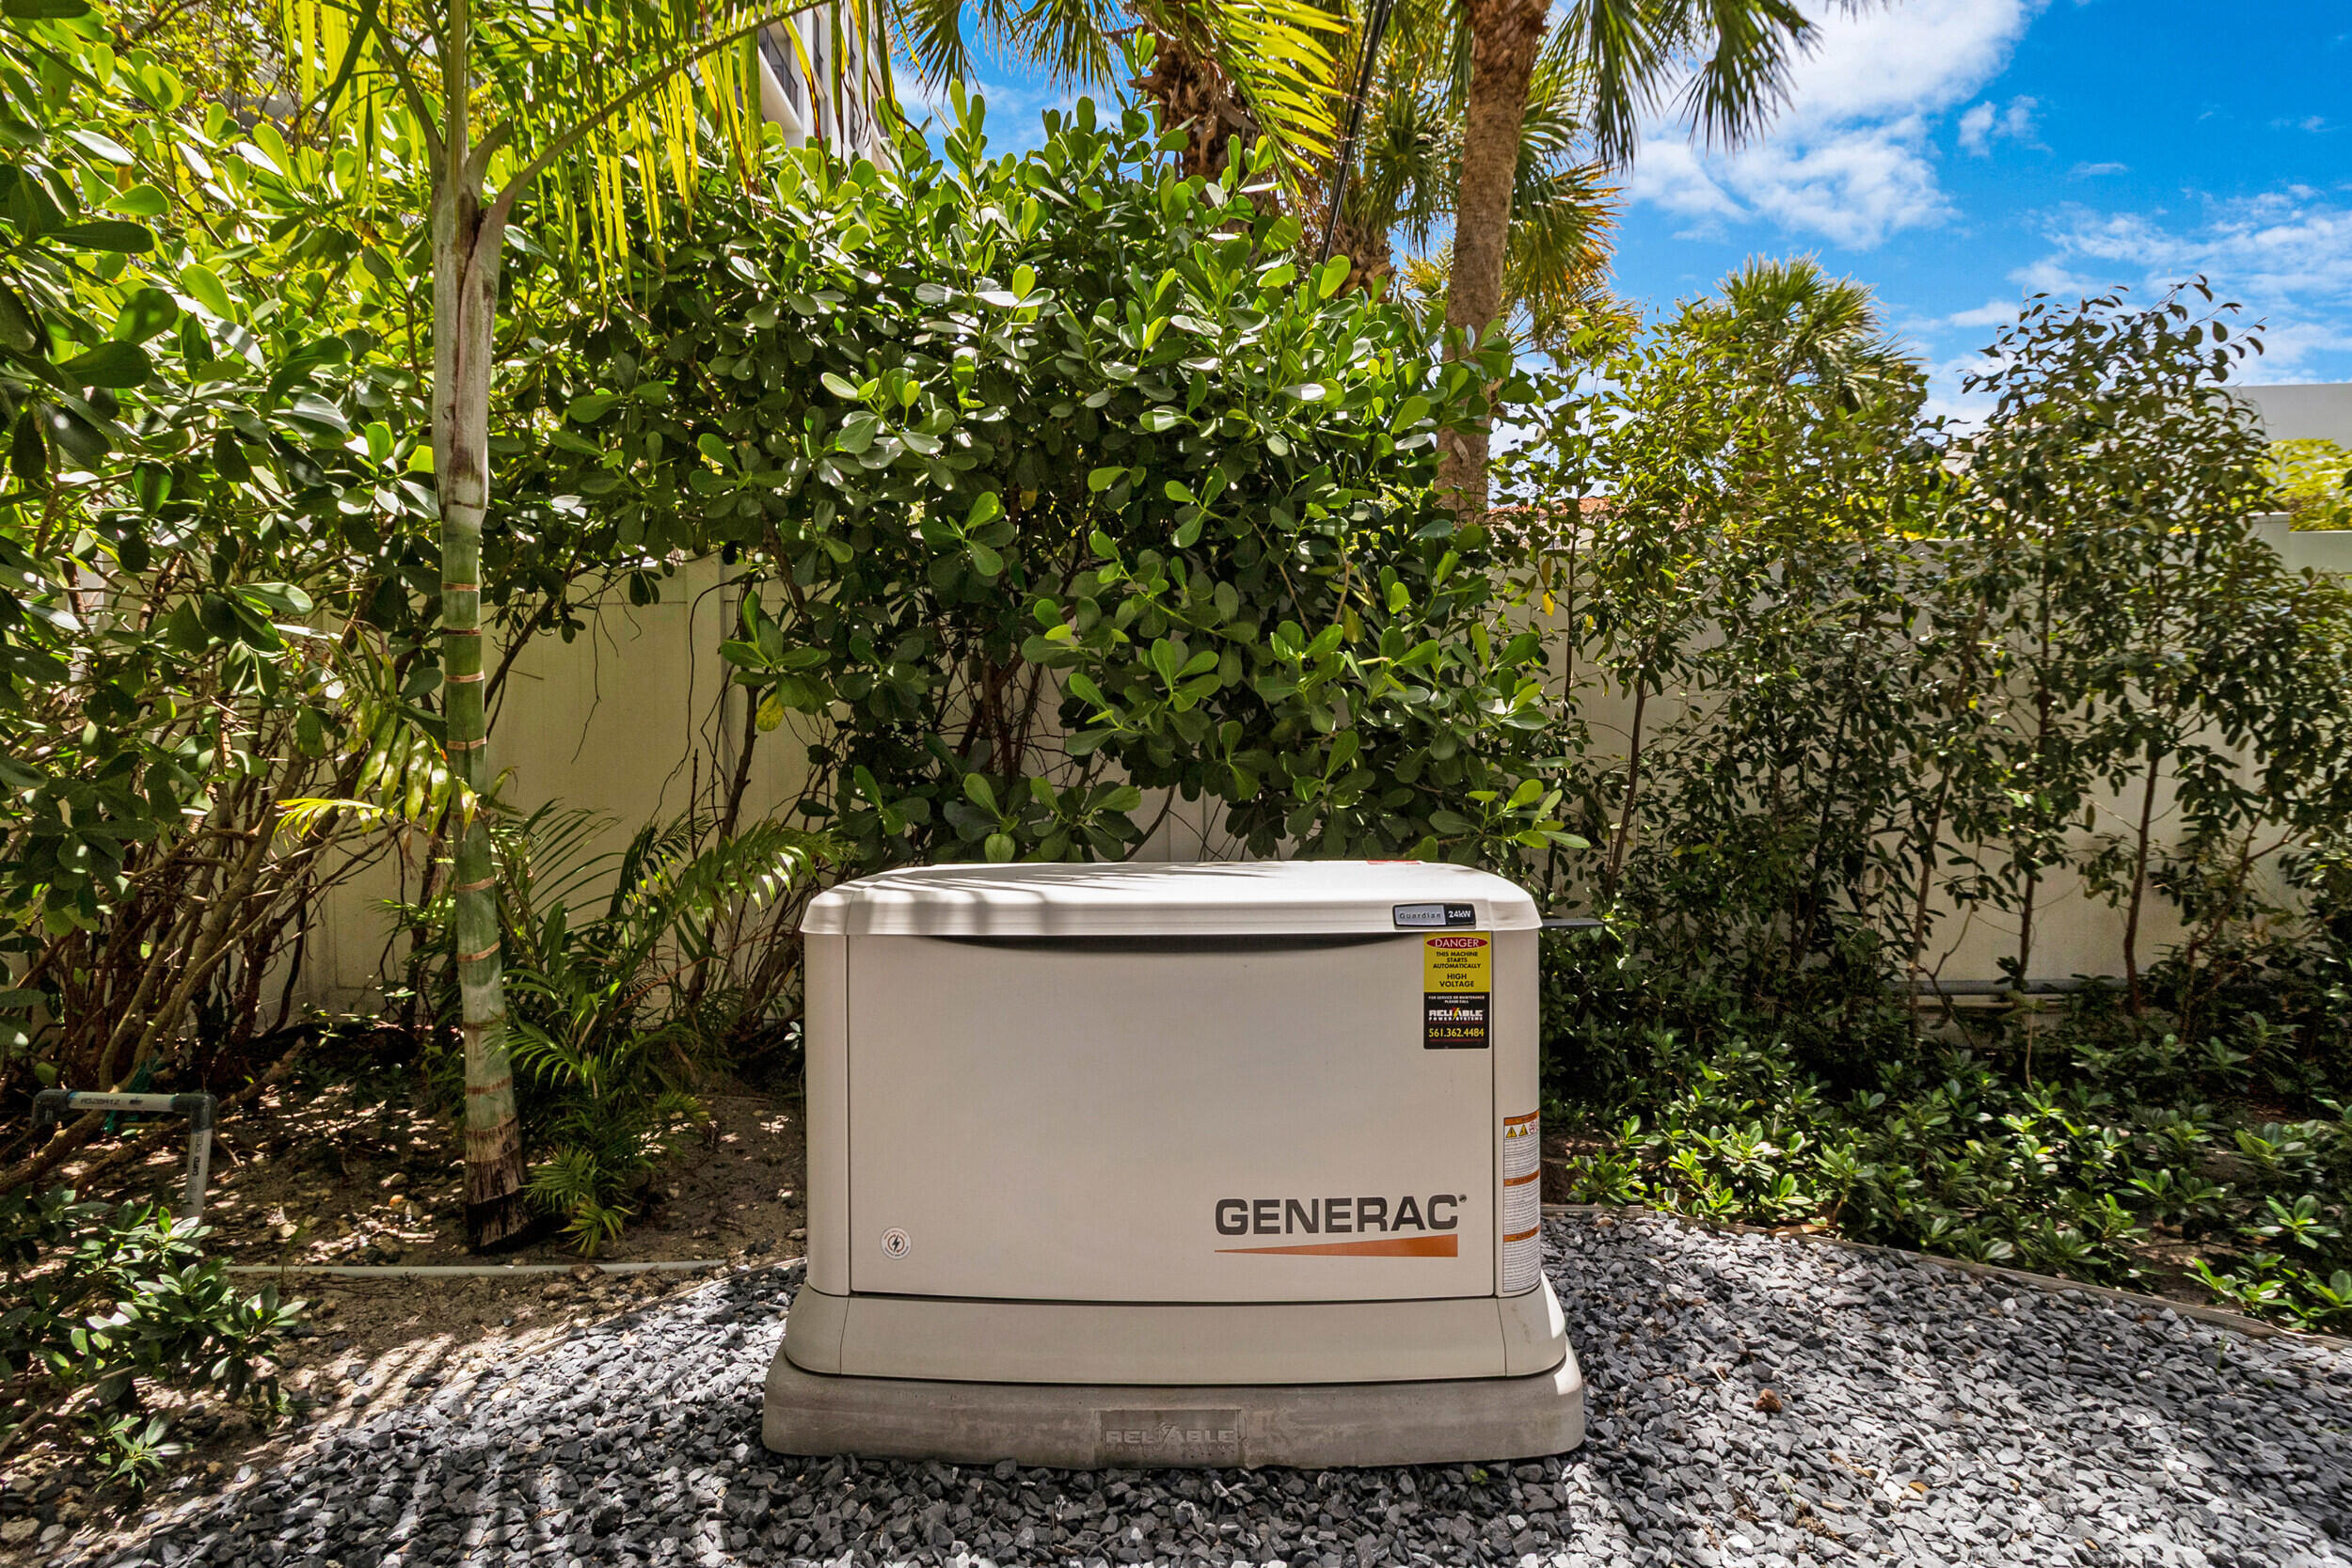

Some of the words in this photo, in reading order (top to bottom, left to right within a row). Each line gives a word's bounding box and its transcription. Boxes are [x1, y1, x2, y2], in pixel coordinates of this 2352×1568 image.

[1399, 911, 1441, 919] Guardian
[1448, 910, 1471, 918] 24kW
[1435, 939, 1479, 948] DANGER
[1428, 1008, 1484, 1017] RELIABLE
[1428, 1028, 1485, 1037] 561.362.4484
[1215, 1194, 1458, 1236] GENERAC
[1105, 1424, 1235, 1444] RELIABLE
